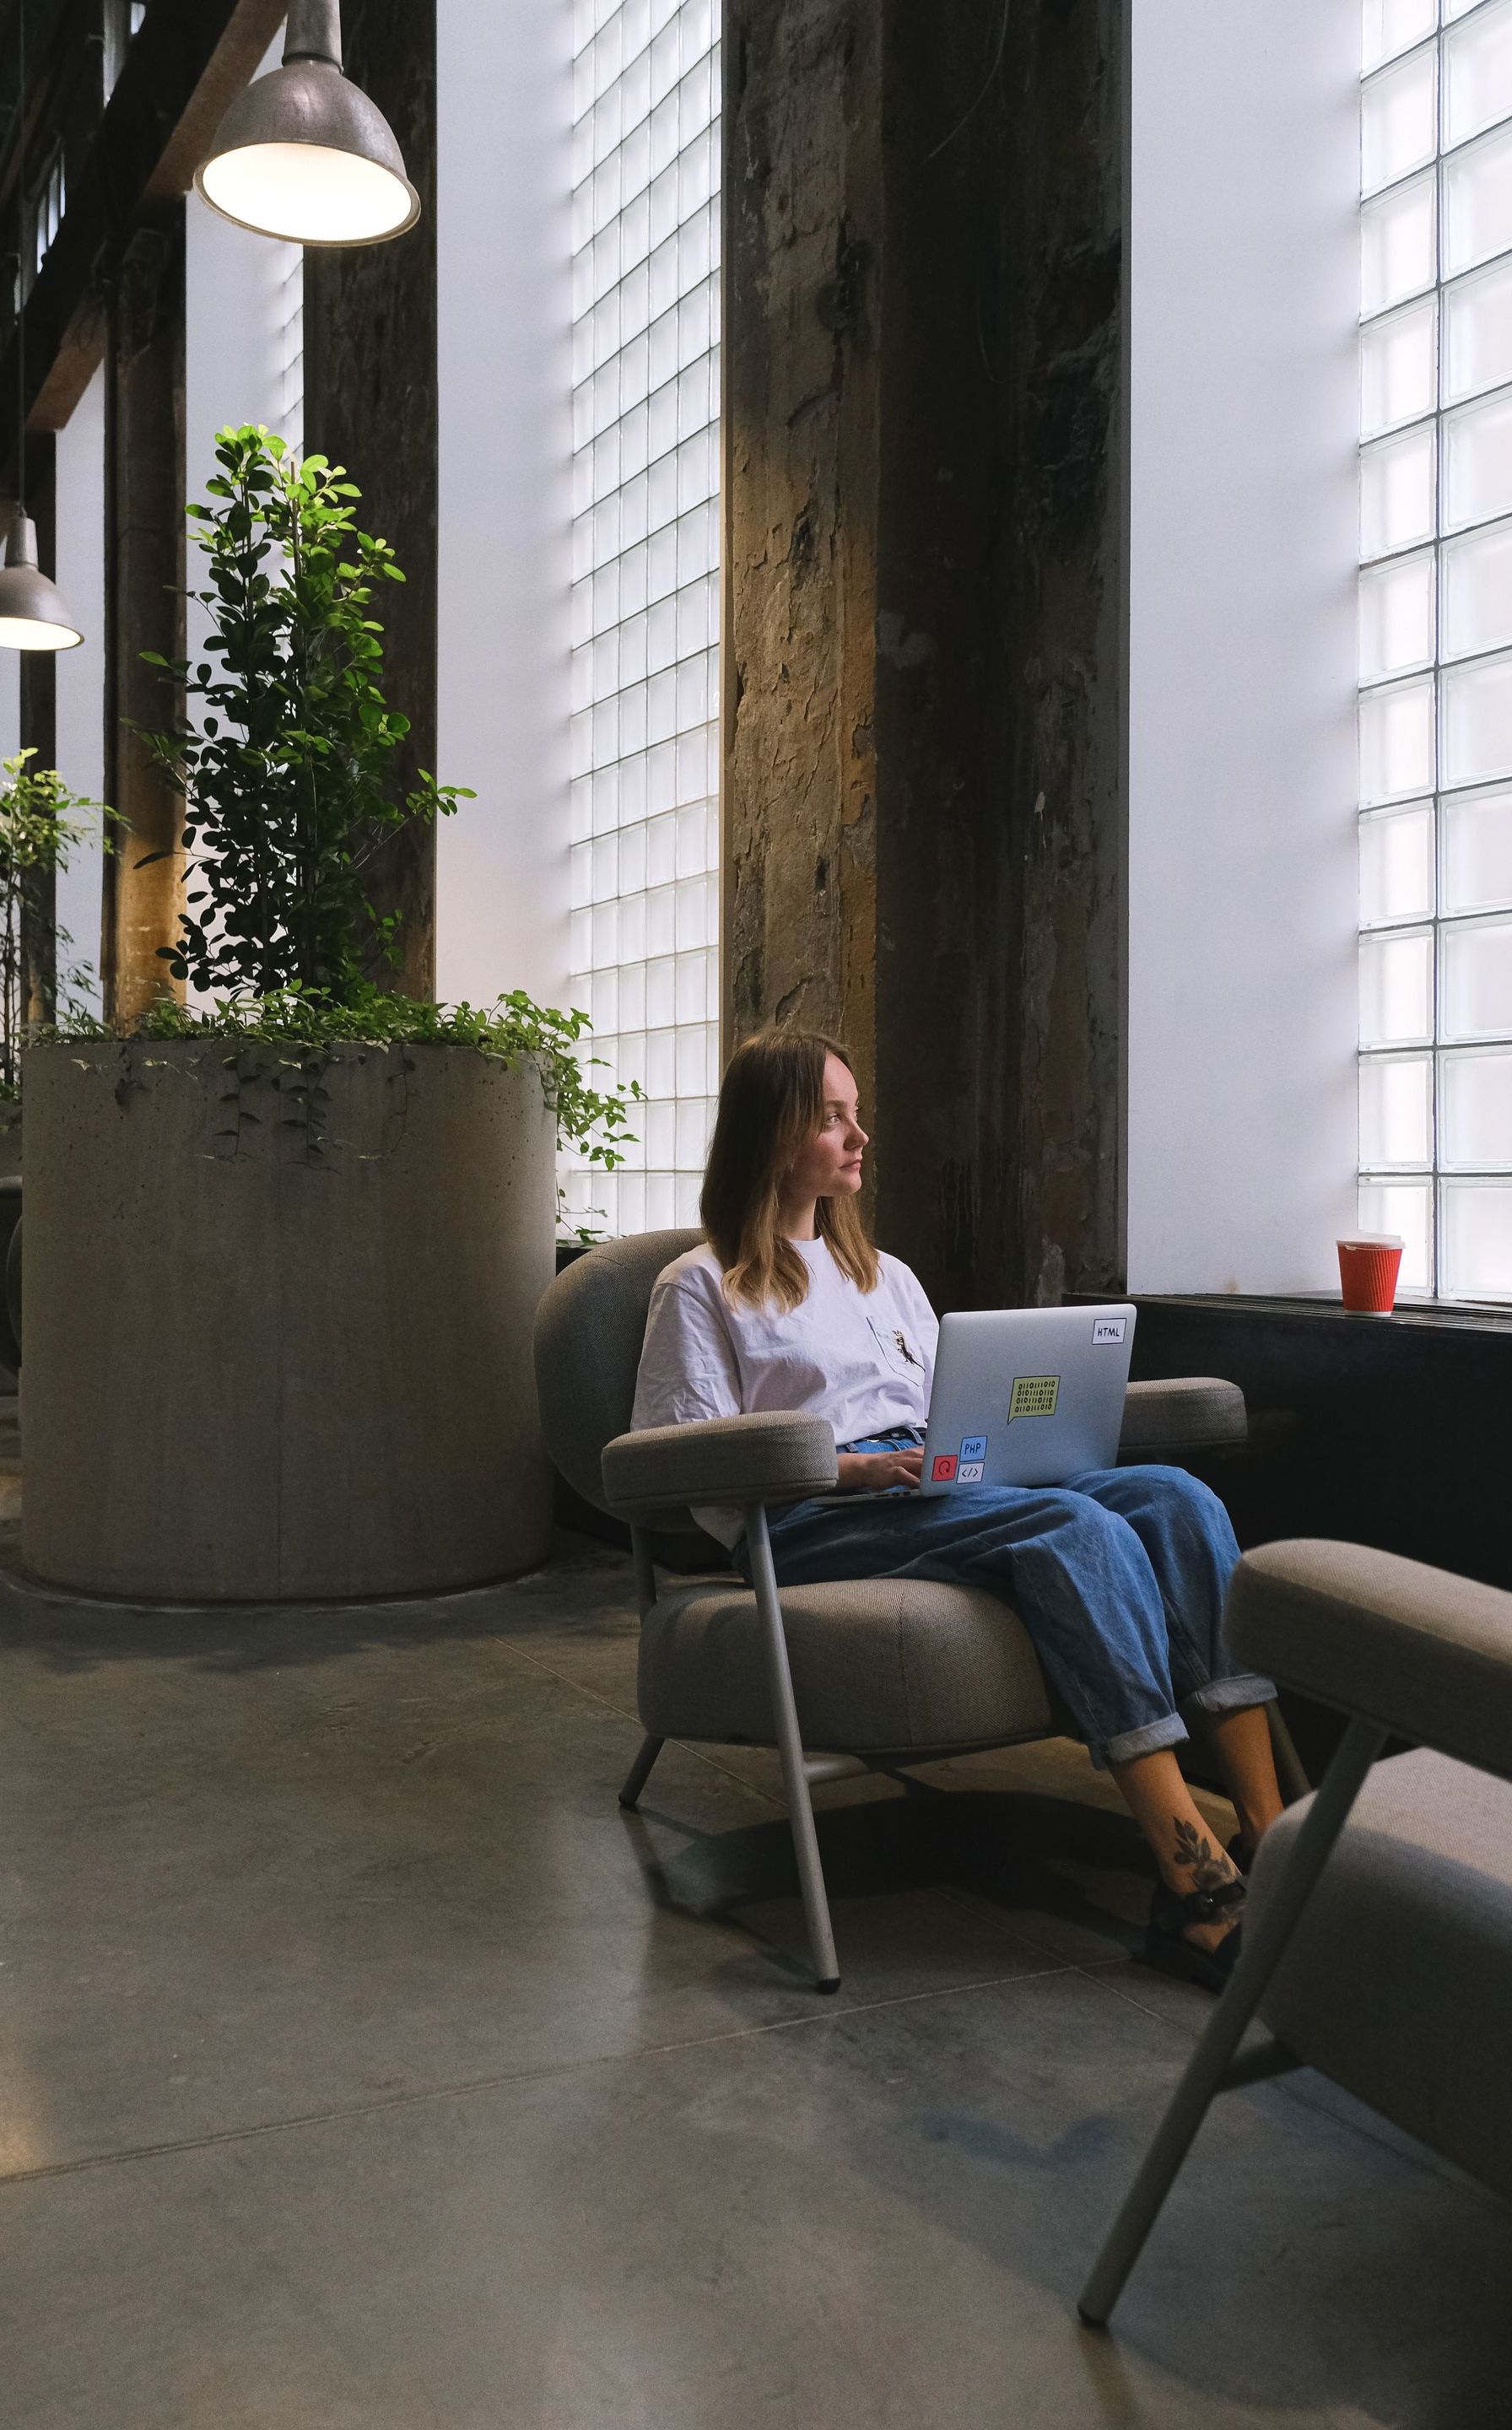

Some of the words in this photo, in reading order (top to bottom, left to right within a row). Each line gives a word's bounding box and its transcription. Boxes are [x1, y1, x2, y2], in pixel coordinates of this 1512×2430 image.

[1097, 1327, 1120, 1336] HTML
[1018, 1380, 1056, 1390] 0110111010
[1014, 1403, 1052, 1412] 0110111010
[964, 1443, 981, 1455] PHP
